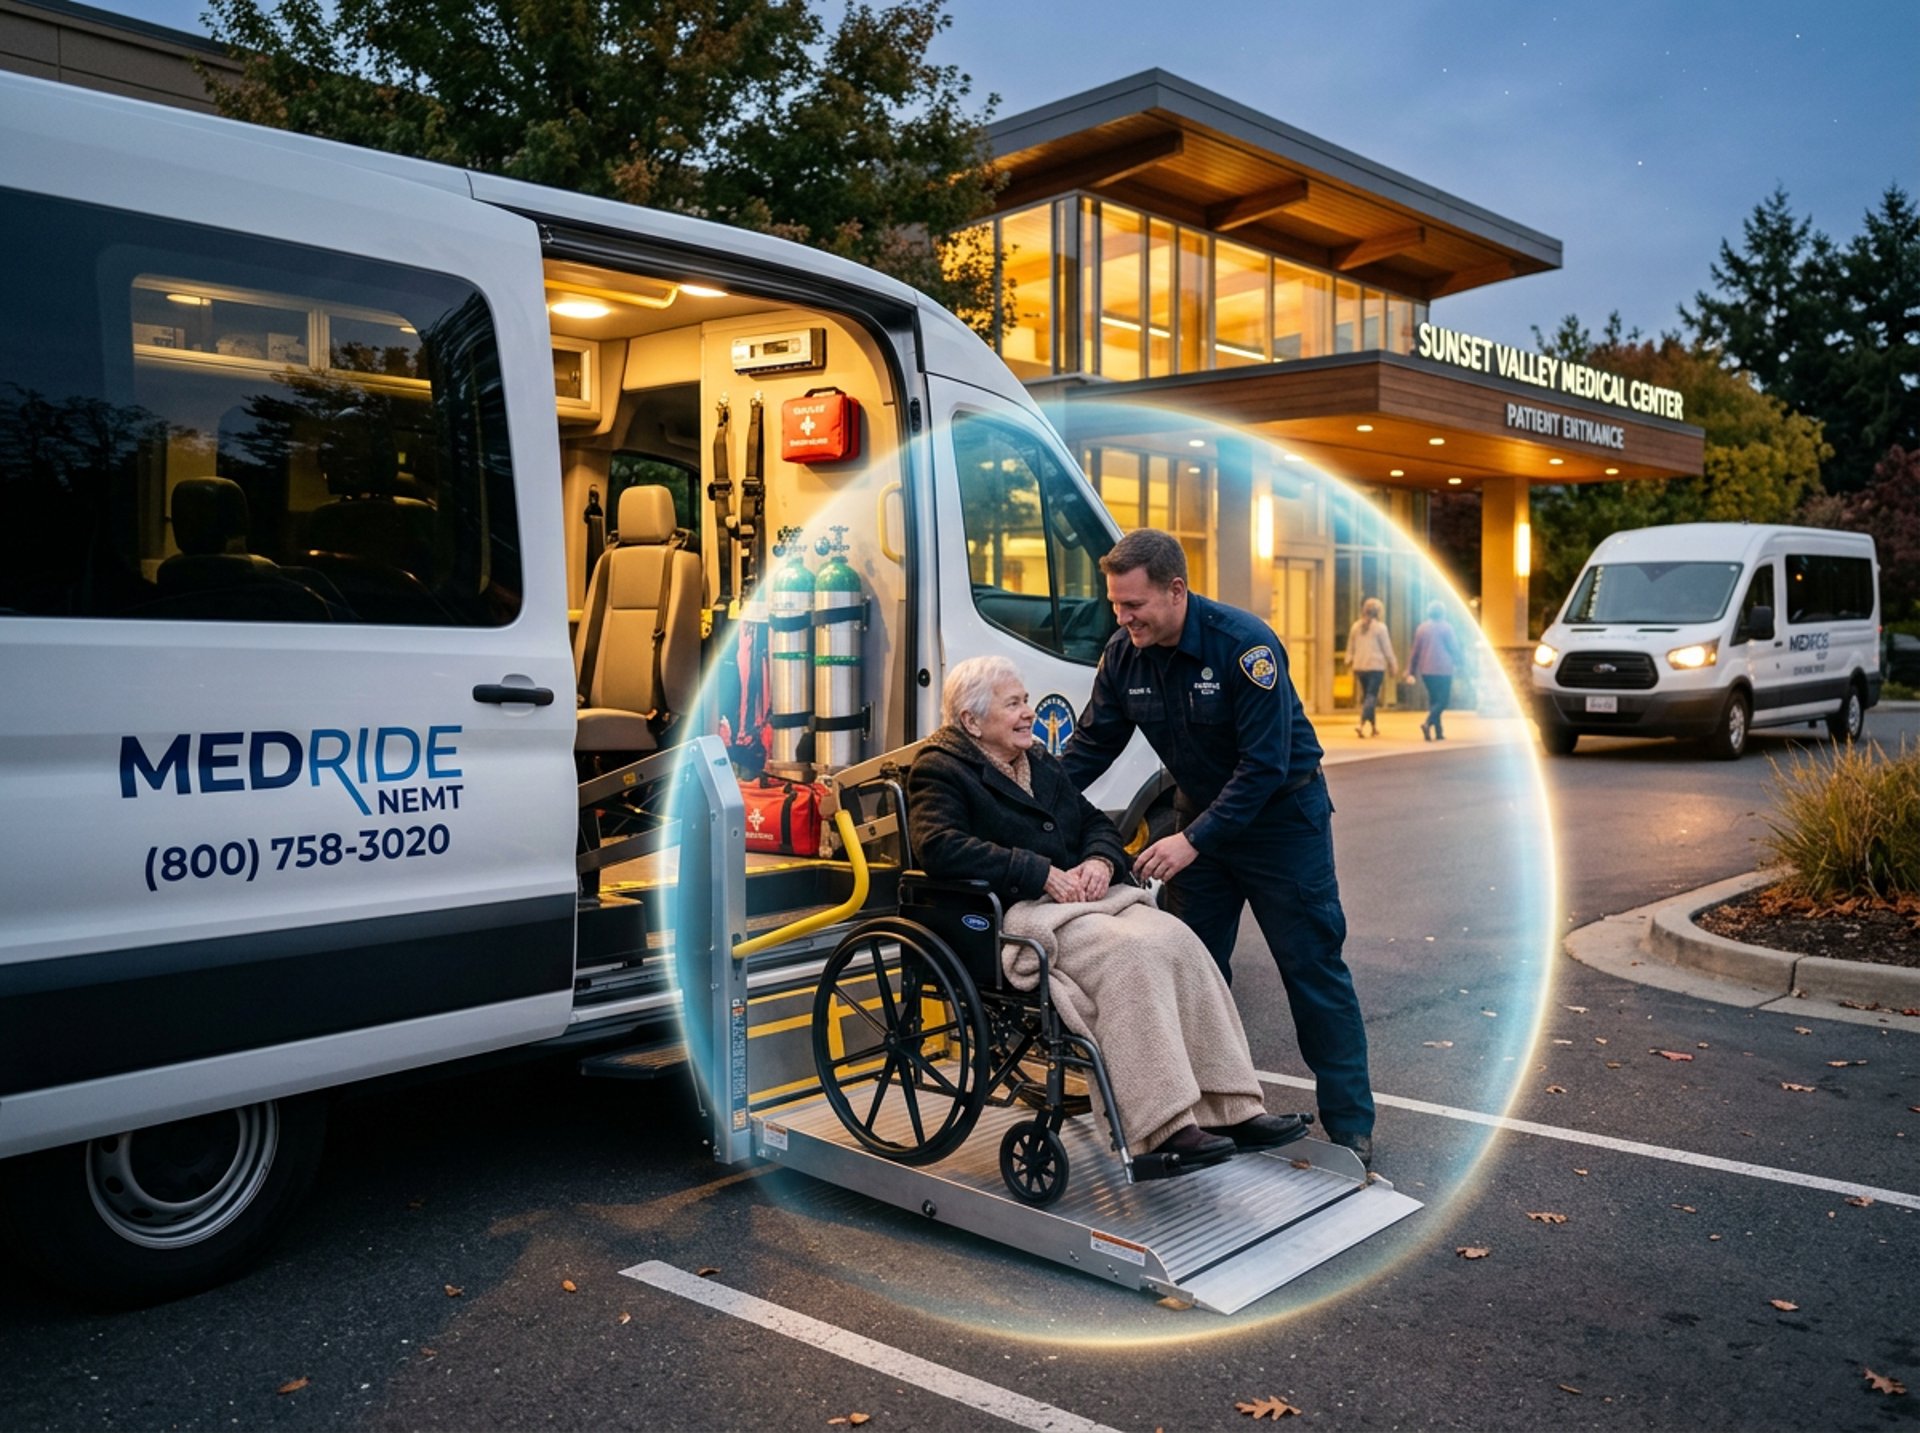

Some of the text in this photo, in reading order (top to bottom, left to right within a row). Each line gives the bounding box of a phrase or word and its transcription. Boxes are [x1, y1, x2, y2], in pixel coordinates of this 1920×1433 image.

[1419, 322, 1684, 420] SUNSET VALLEY MEDICAL CENTER
[1507, 403, 1560, 437] PATIENT
[119, 725, 463, 816] MEDRIDE
[378, 785, 464, 815] NEMT
[145, 824, 450, 891] (800) 758-3020
